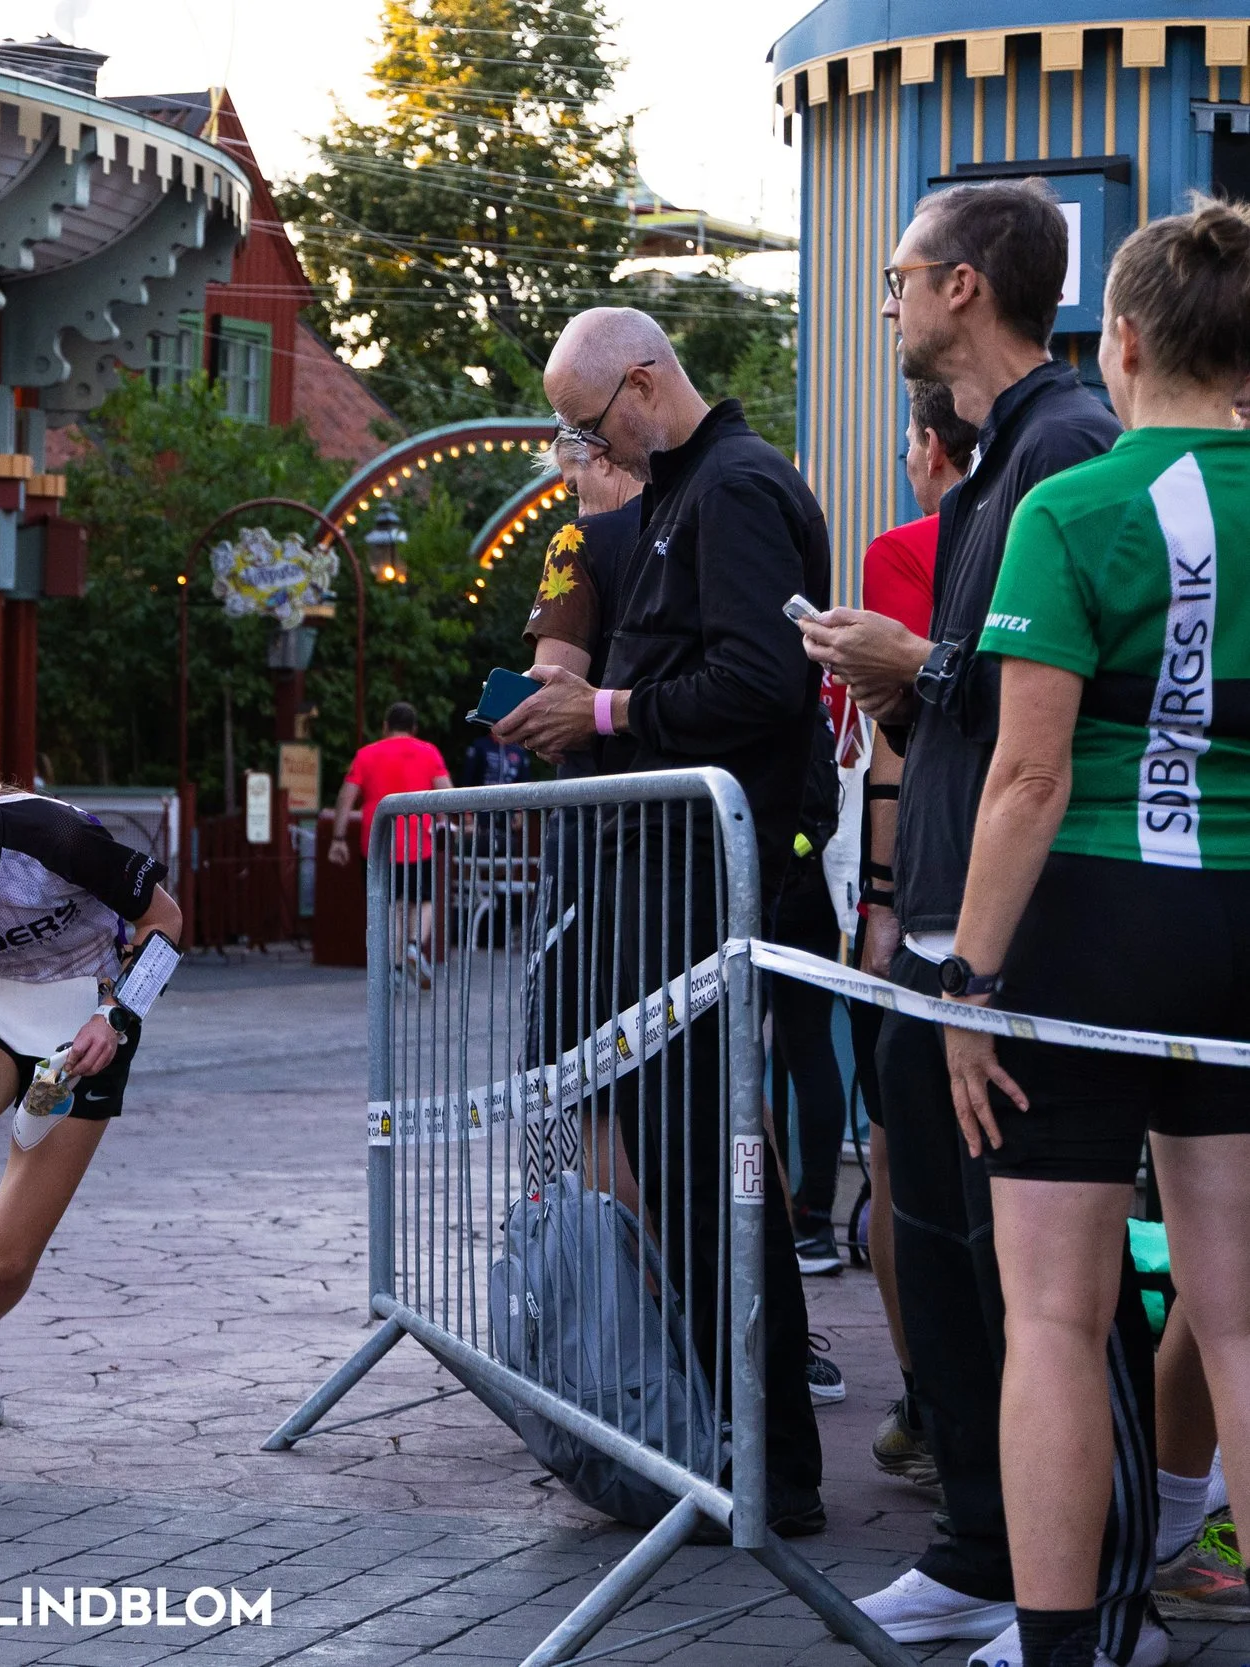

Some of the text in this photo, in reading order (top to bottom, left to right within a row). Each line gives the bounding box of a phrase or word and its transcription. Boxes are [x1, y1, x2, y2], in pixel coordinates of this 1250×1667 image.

[1176, 554, 1212, 601] IK
[133, 855, 155, 898] SÖDER
[691, 968, 720, 994] OCKHOLM
